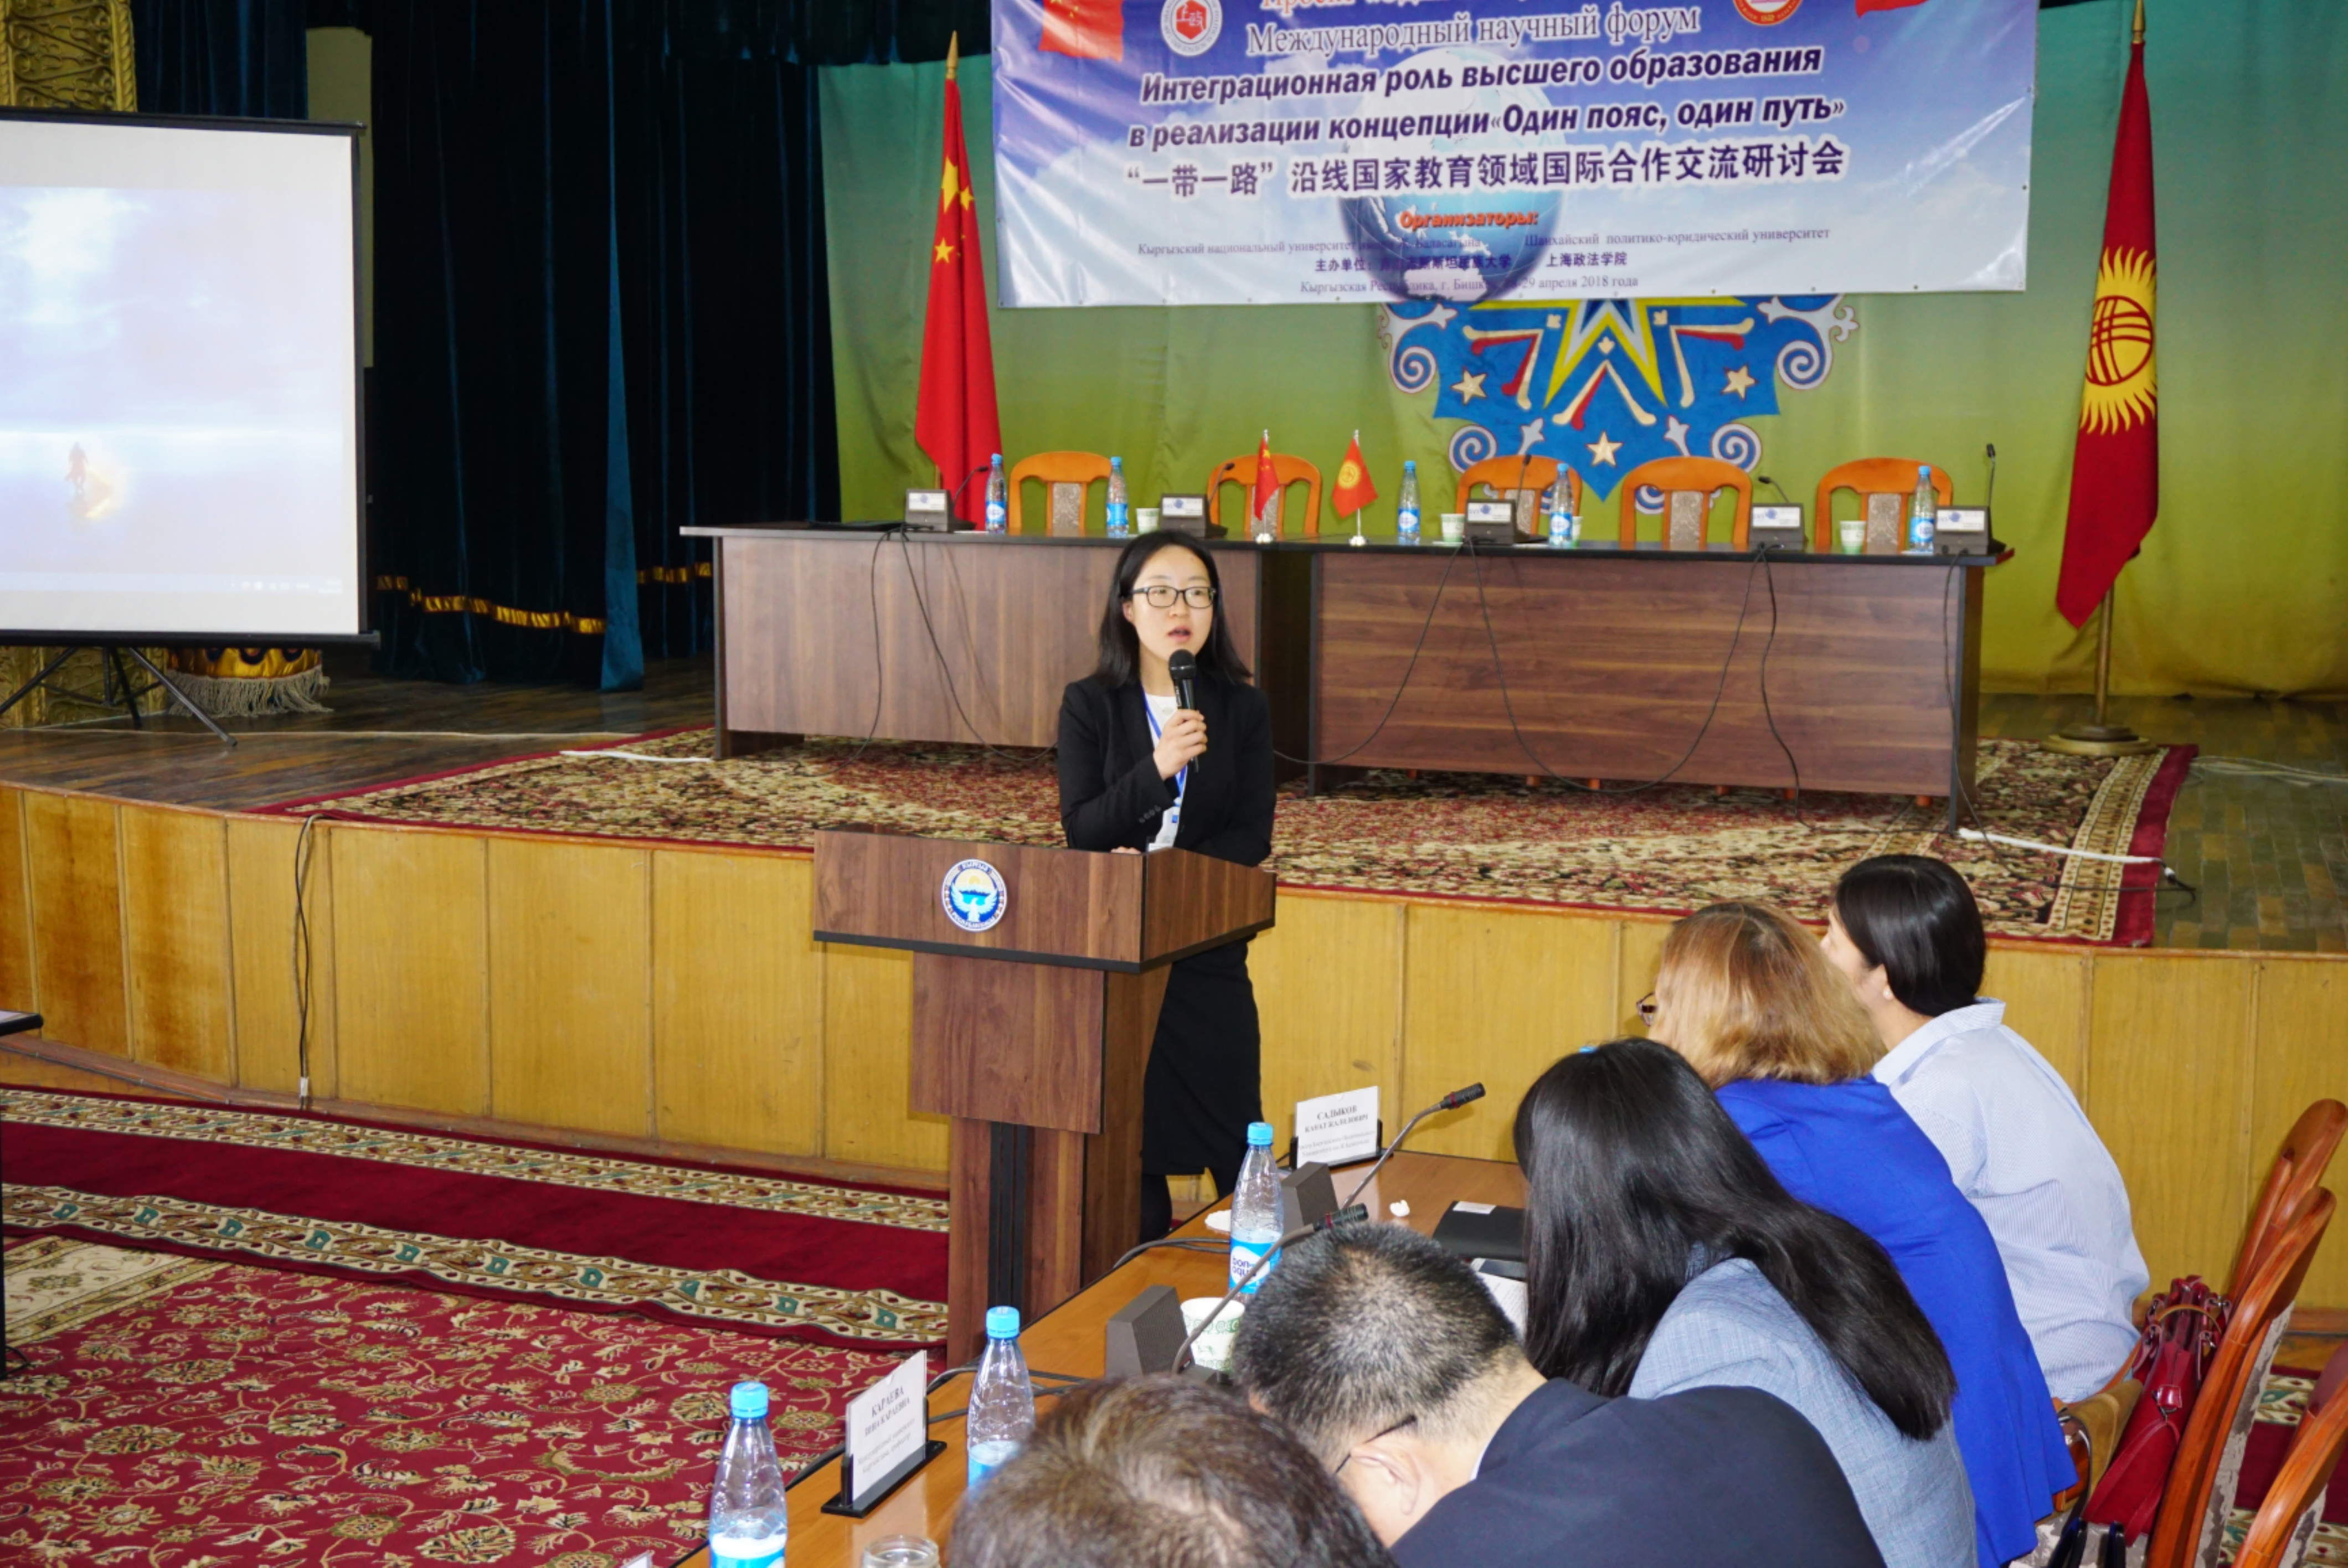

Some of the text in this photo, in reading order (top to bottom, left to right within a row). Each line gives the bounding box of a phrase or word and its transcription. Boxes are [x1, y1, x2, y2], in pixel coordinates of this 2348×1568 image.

[1249, 14, 1470, 57] Международный
[1480, 7, 1597, 48] научный
[1607, 4, 1698, 42] форум
[1142, 49, 1822, 104] Интеграционная роль высшего образования
[1129, 127, 1145, 147] в
[1152, 120, 1321, 152] реализации
[1587, 104, 1667, 133] пояс,
[1677, 101, 1754, 128] один
[1762, 97, 1844, 127] путь»
[1291, 140, 1844, 193] 沿线国家教育领域国际合作交流研讨会
[1400, 211, 1538, 231] Организаторы:
[1525, 229, 1830, 247] Шанхайский политико-юридический университет
[1138, 243, 1204, 257] Кыргызский
[1208, 241, 1285, 254] национальный
[1288, 240, 1355, 254] университет
[1546, 251, 1628, 267] 上海政法学院
[1300, 281, 1367, 295] Кыргызская
[1441, 281, 1450, 290] г.
[1538, 278, 1578, 291] апреля
[1581, 276, 1609, 287] 2018
[1611, 277, 1639, 287] года
[1316, 1105, 1358, 1121] САДЫКОВ
[871, 1385, 905, 1418] КАРАЕВА
